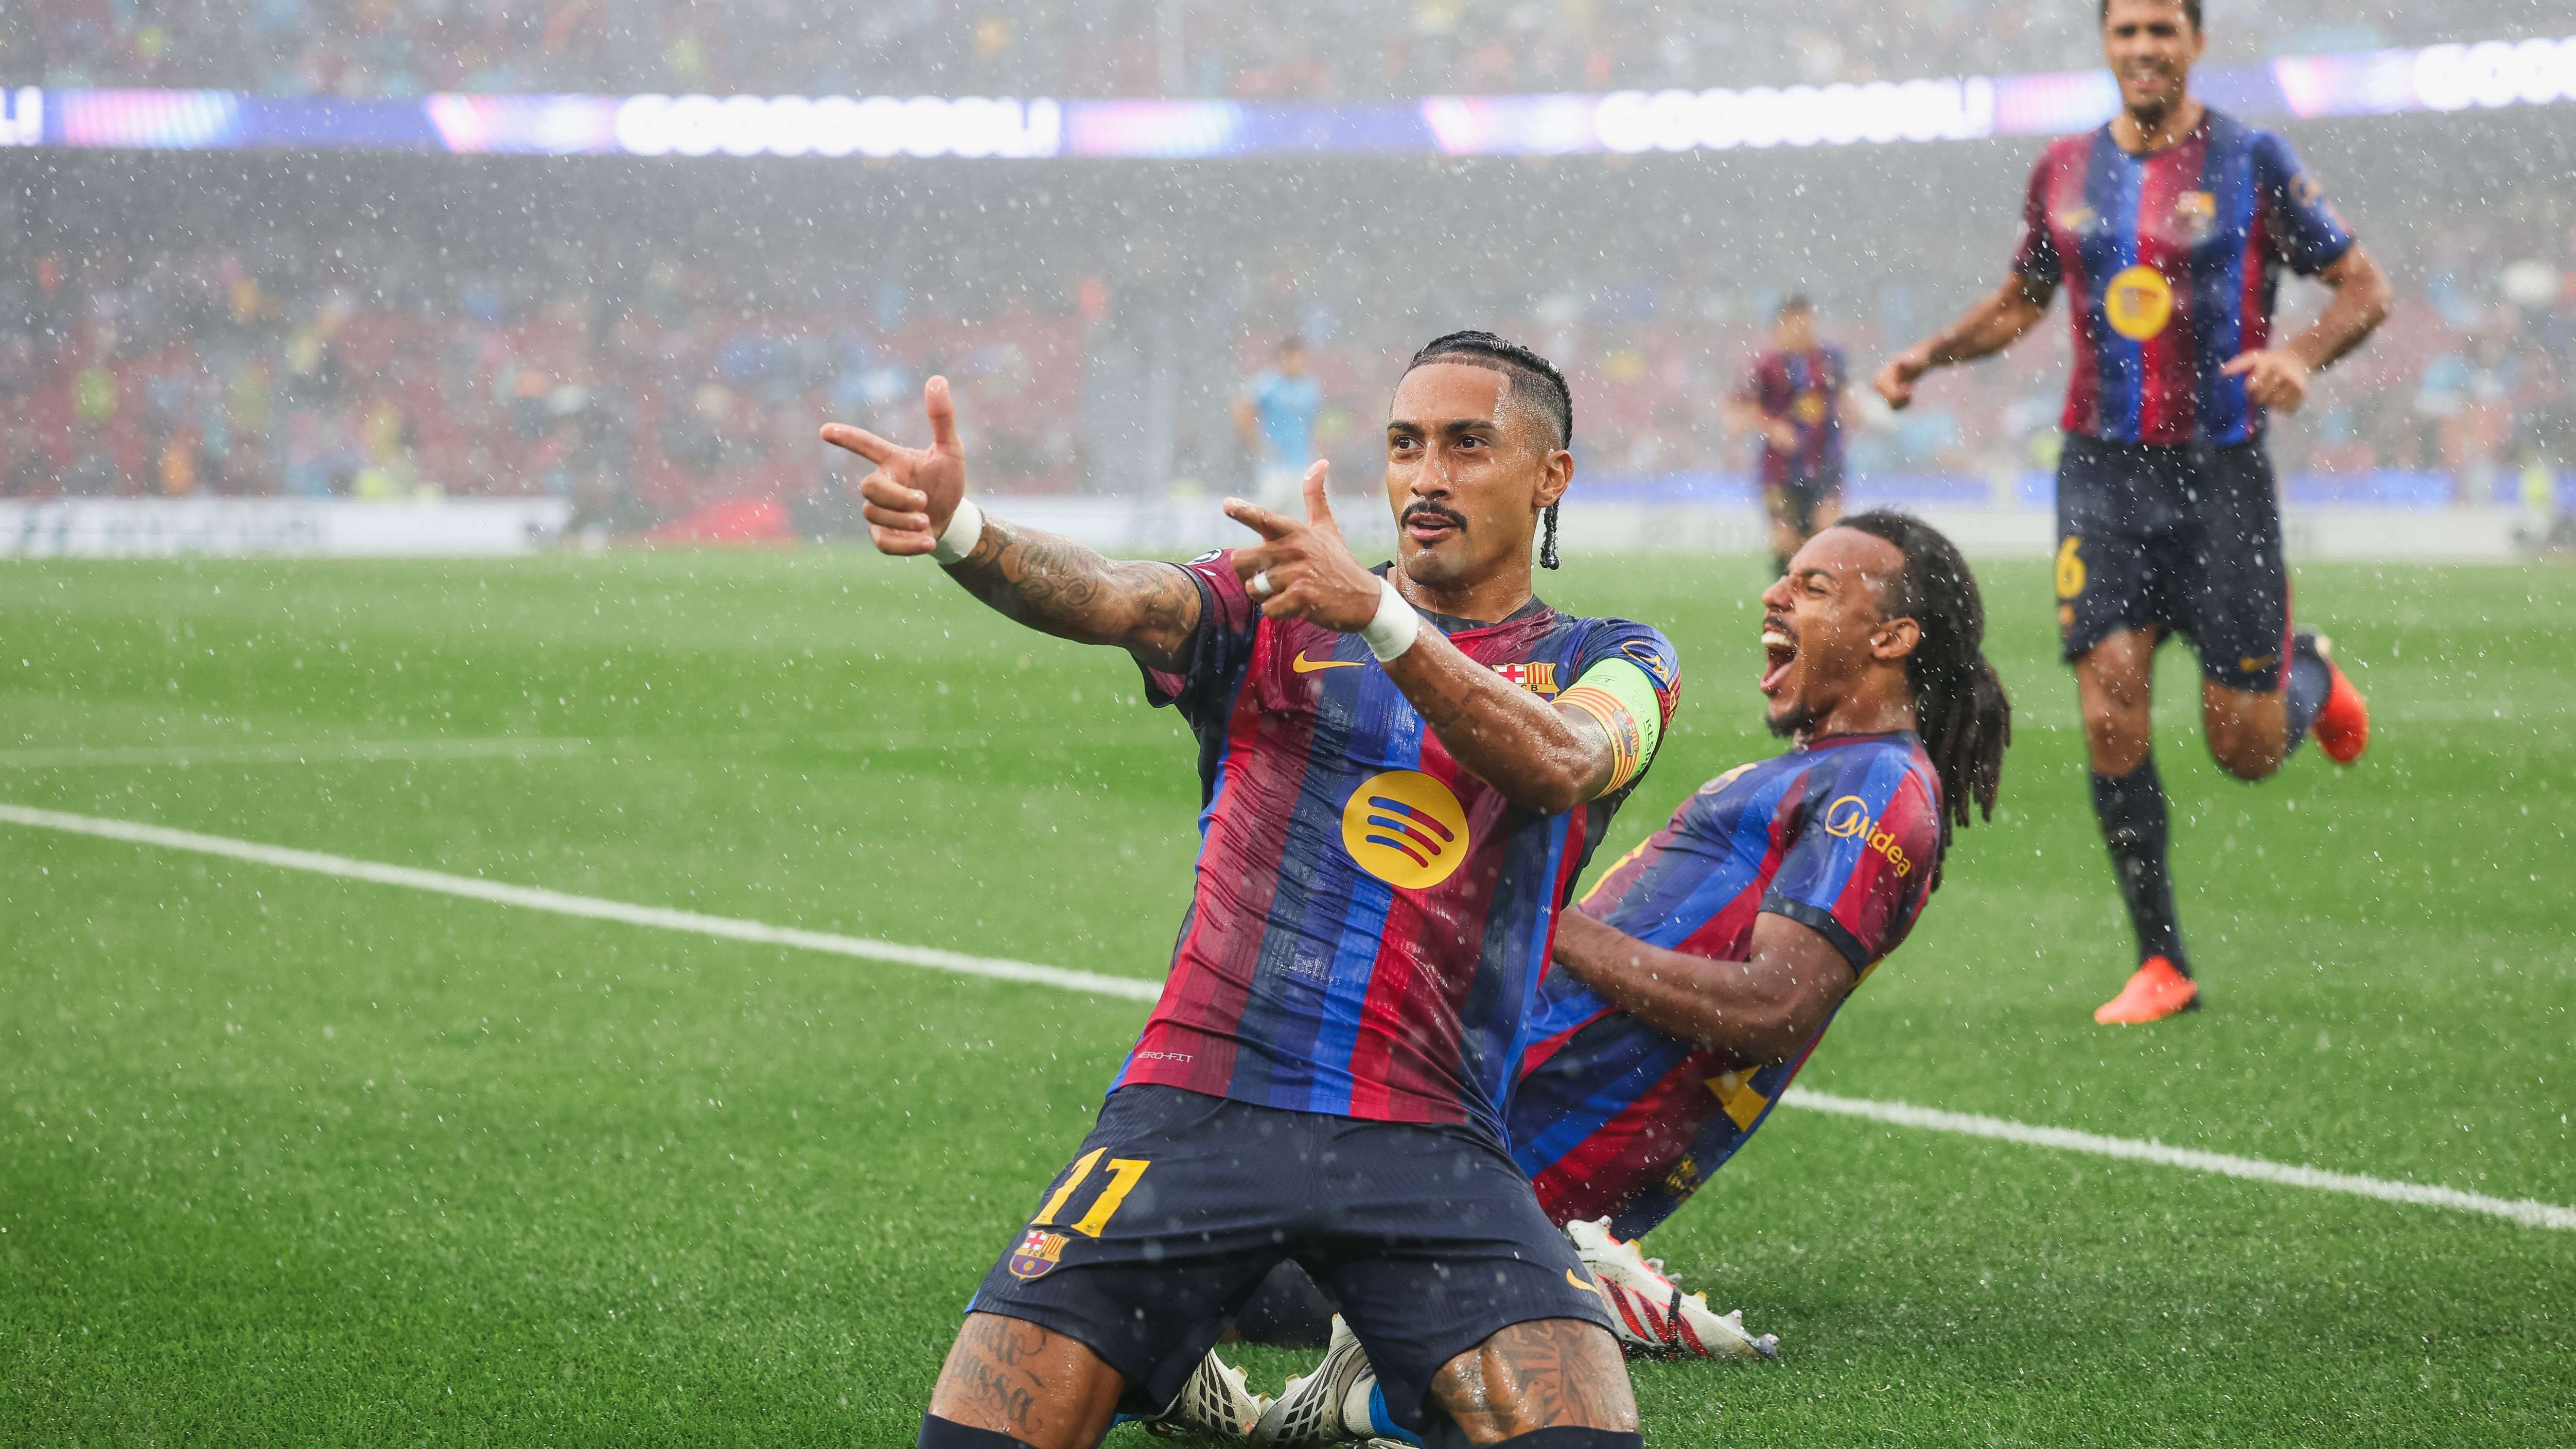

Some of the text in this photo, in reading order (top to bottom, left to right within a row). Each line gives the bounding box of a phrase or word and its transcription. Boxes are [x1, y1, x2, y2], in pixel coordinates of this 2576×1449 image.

[2056, 534, 2087, 599] 6
[1520, 684, 1538, 692] CB
[1825, 795, 1911, 877] Midea
[1030, 1146, 1151, 1238] 11
